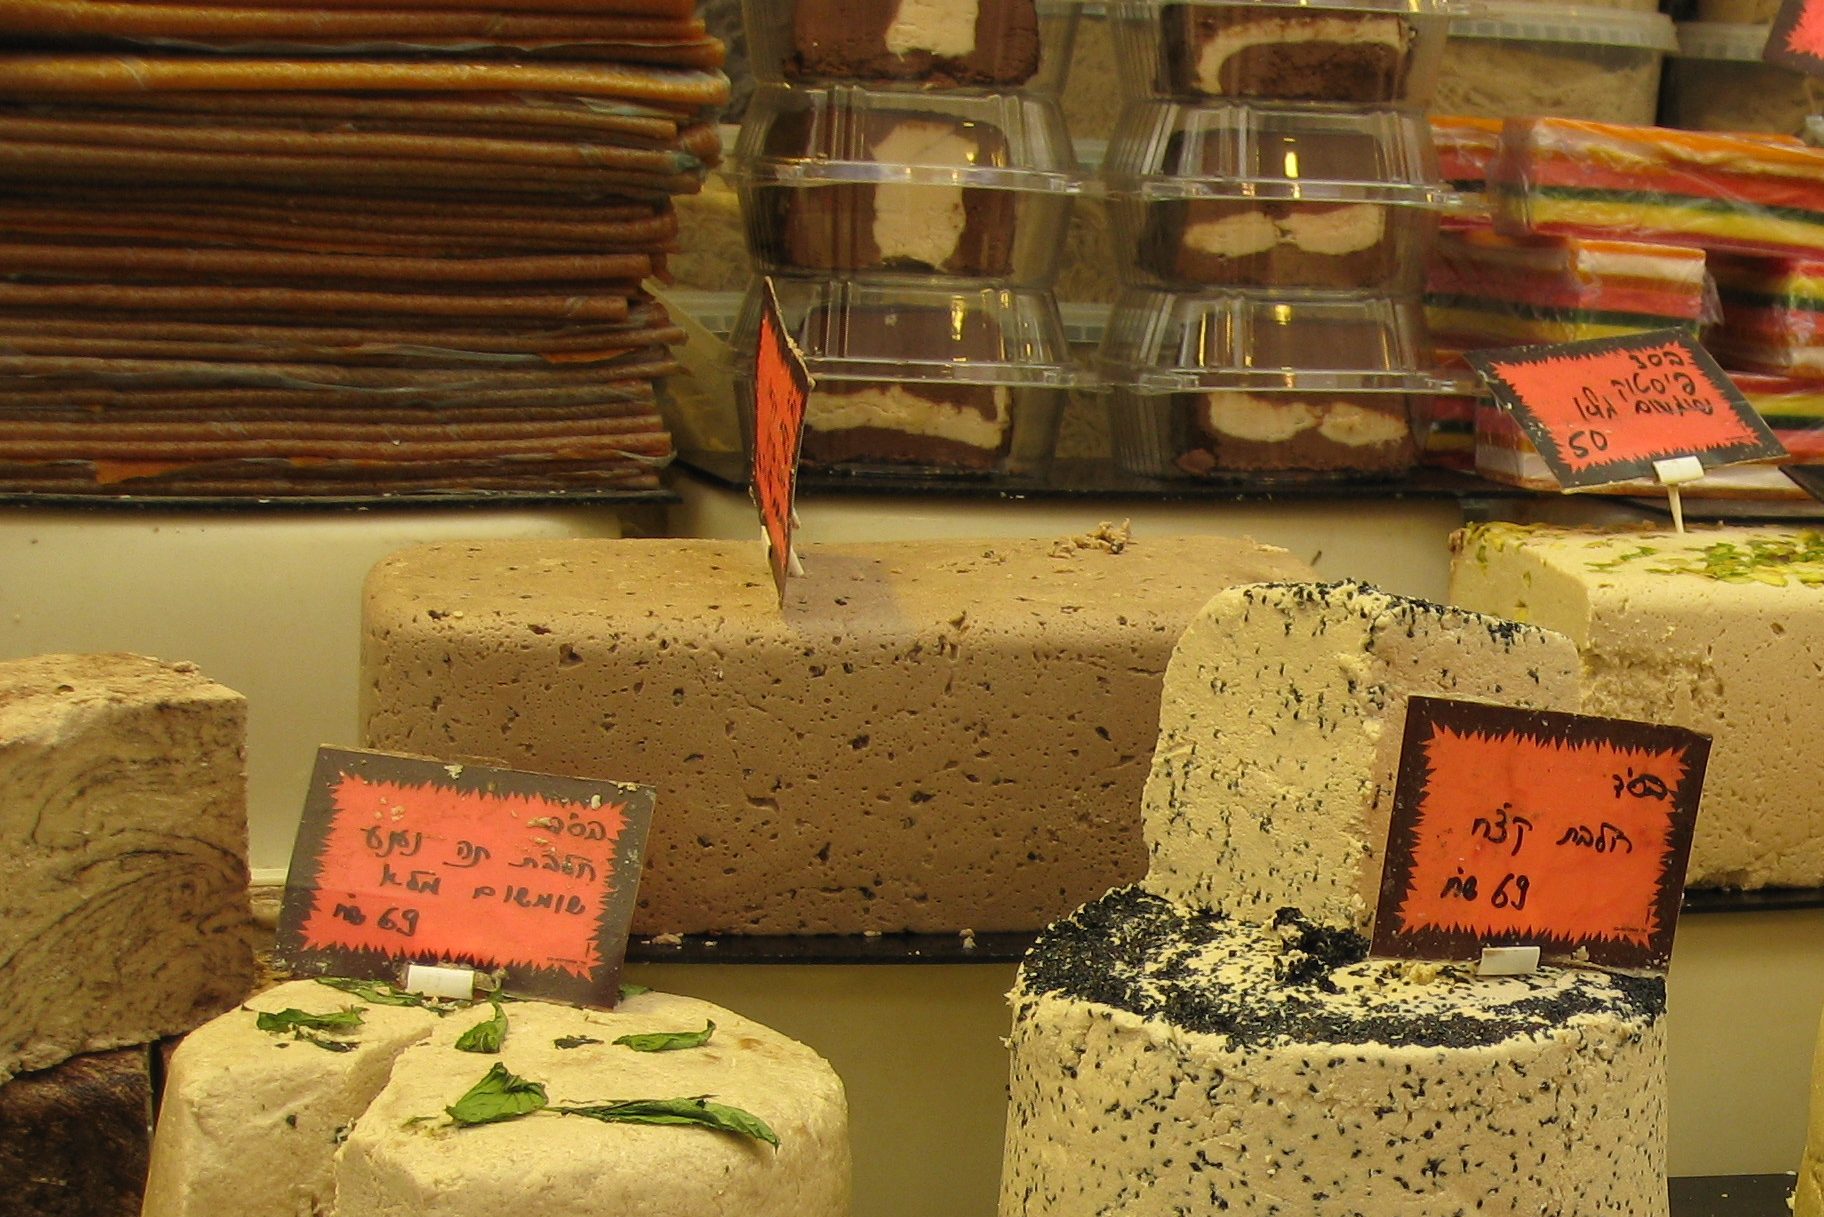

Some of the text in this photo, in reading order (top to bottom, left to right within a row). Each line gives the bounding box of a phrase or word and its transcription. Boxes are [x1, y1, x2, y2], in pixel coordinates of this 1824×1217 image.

[1569, 430, 1608, 458] 50
[1556, 822, 1633, 854] חלבת
[508, 854, 597, 882] חלבת
[380, 863, 586, 914] שומשום מלא
[1491, 873, 1530, 910] 69
[377, 908, 420, 937] 69
